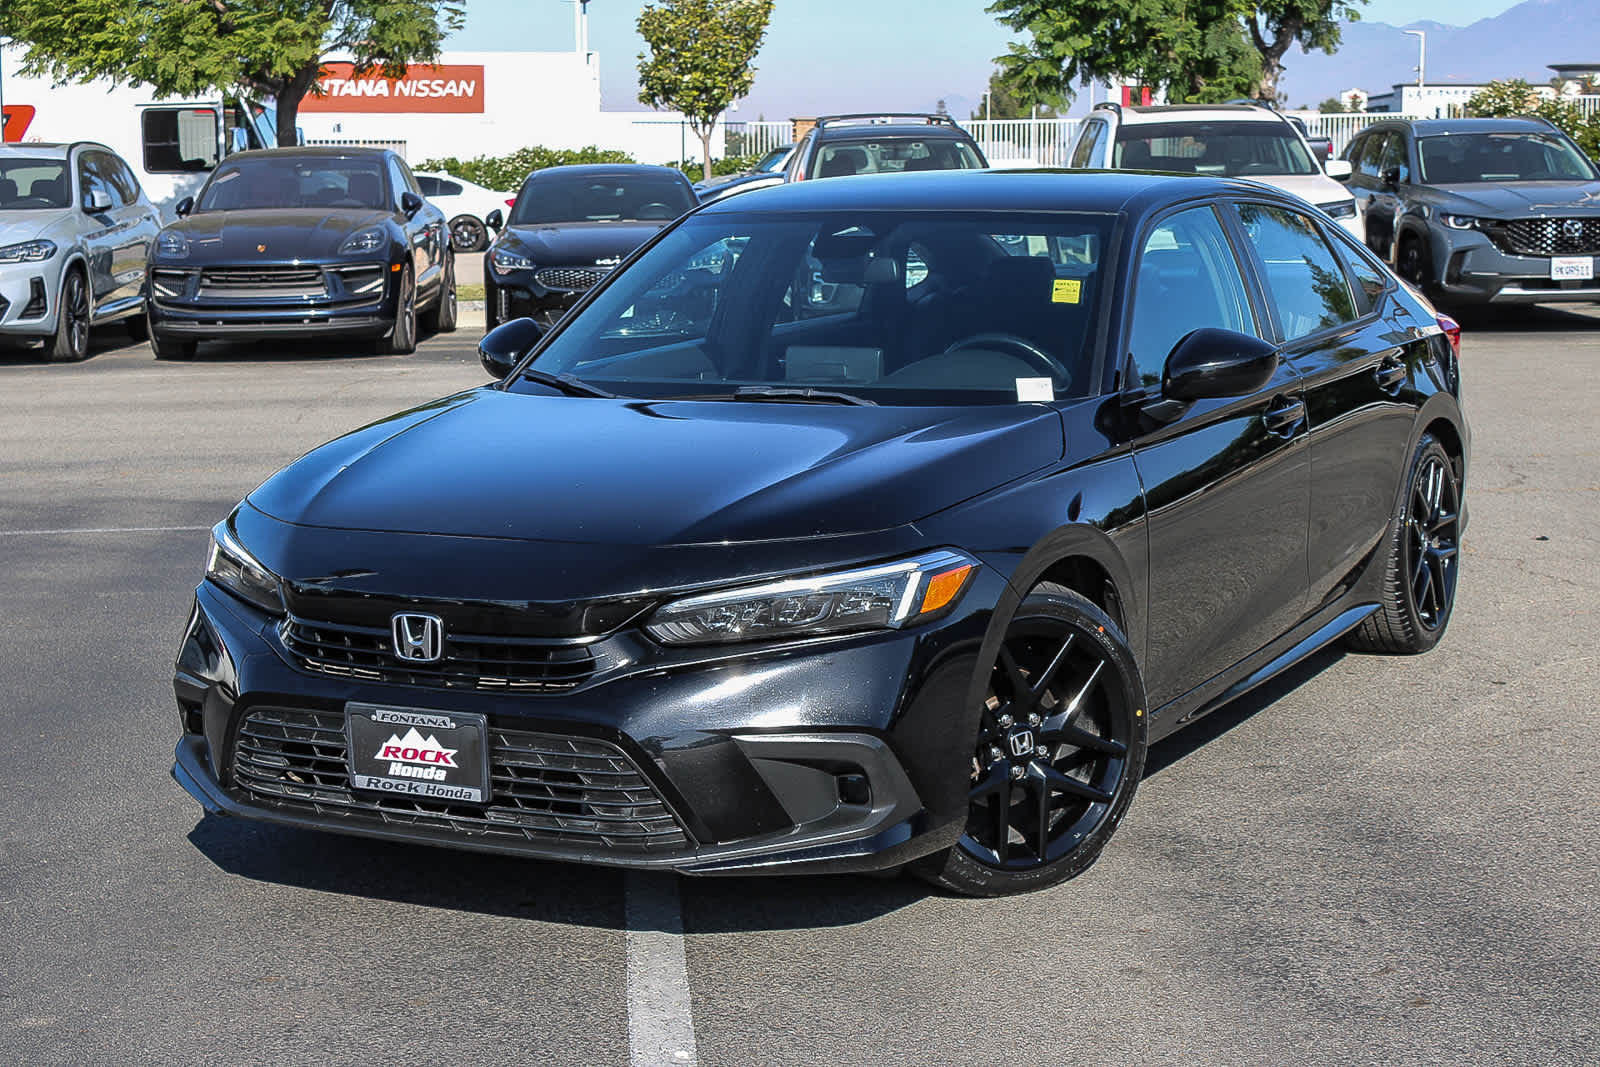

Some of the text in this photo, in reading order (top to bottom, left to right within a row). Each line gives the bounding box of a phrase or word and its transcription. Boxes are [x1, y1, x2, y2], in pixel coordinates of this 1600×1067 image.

[394, 79, 475, 97] NISSAN
[381, 713, 448, 727] FONTANA
[383, 745, 452, 765] ROCK
[388, 761, 447, 781] Honda
[366, 778, 473, 800] Rock Honda
